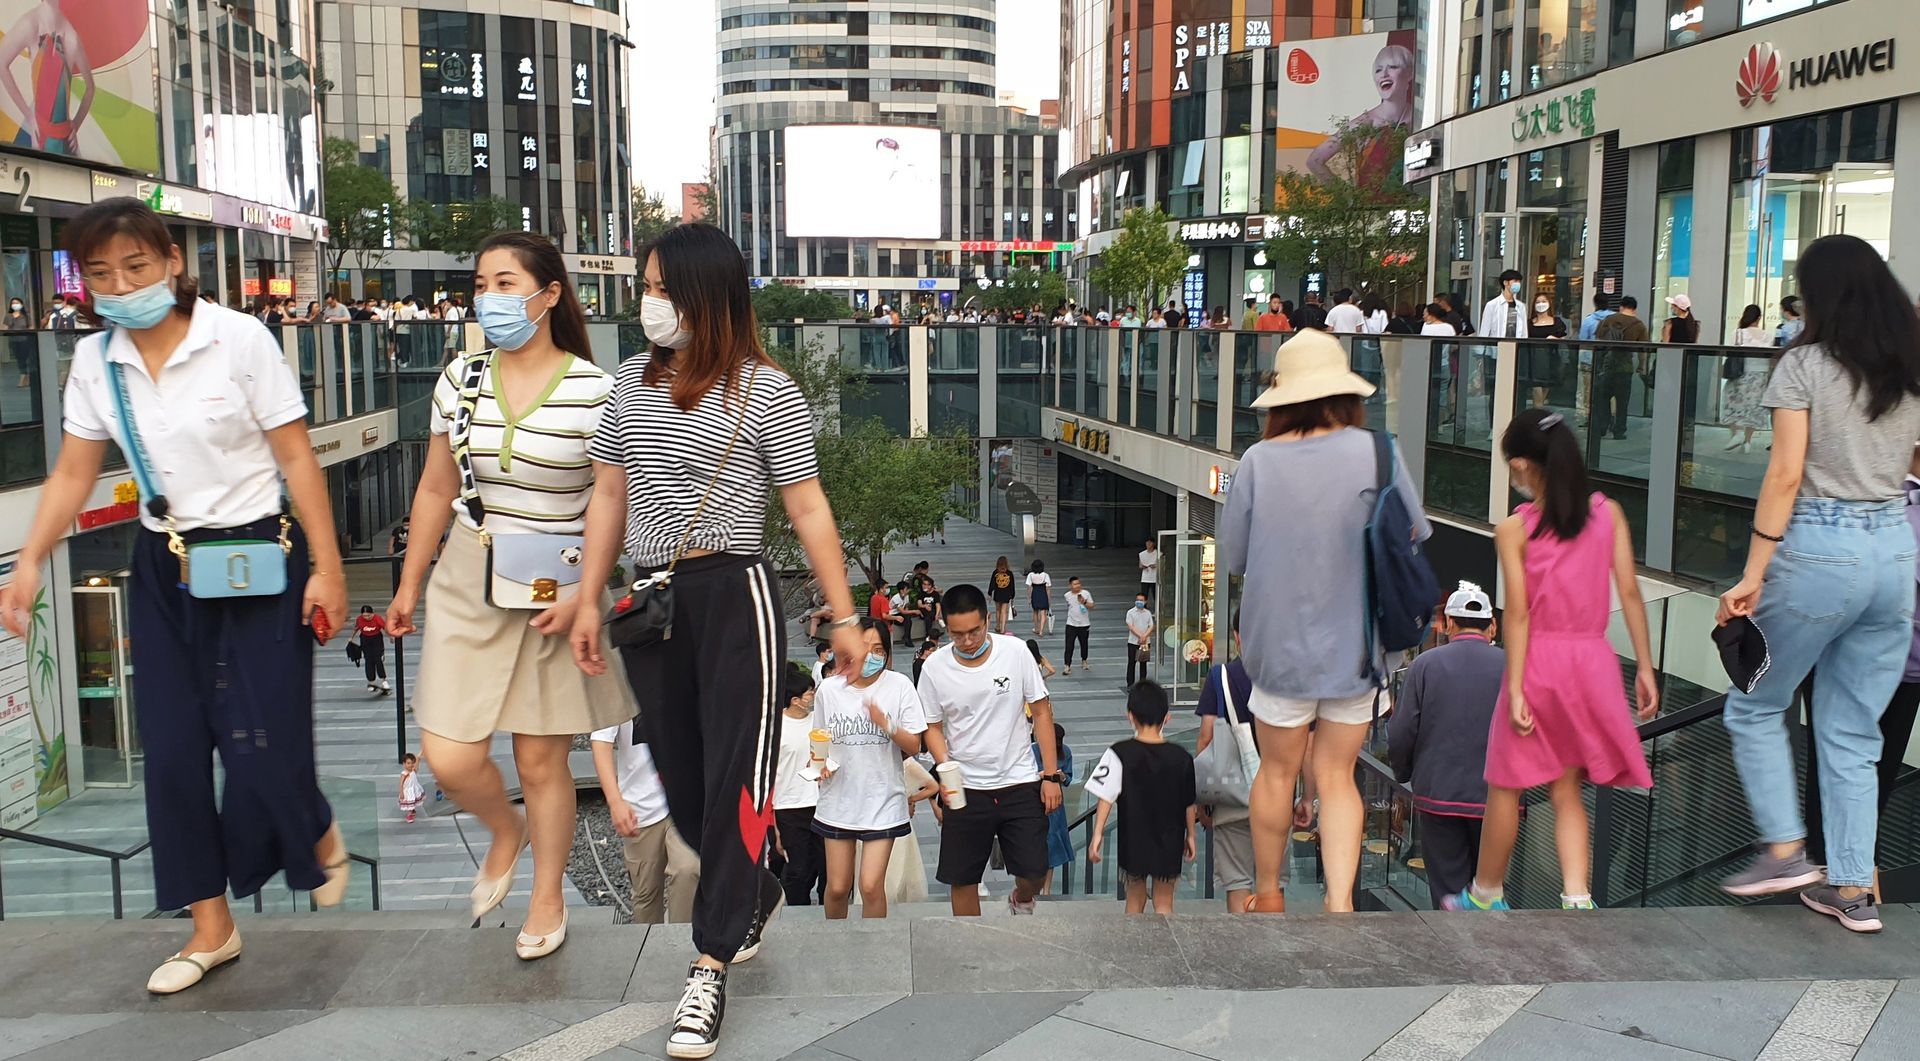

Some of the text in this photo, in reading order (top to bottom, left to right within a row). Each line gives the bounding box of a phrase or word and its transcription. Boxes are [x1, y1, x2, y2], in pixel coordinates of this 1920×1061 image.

[1246, 20, 1271, 35] SPA
[1174, 25, 1190, 91] SPA
[1788, 38, 1896, 90] HUAWEI
[473, 133, 488, 168] 图文
[522, 136, 537, 171] 快印
[14, 166, 34, 213] 2
[918, 279, 937, 288] ESP
[1194, 273, 1204, 309] 立等可取
[1092, 765, 1110, 785] 2
